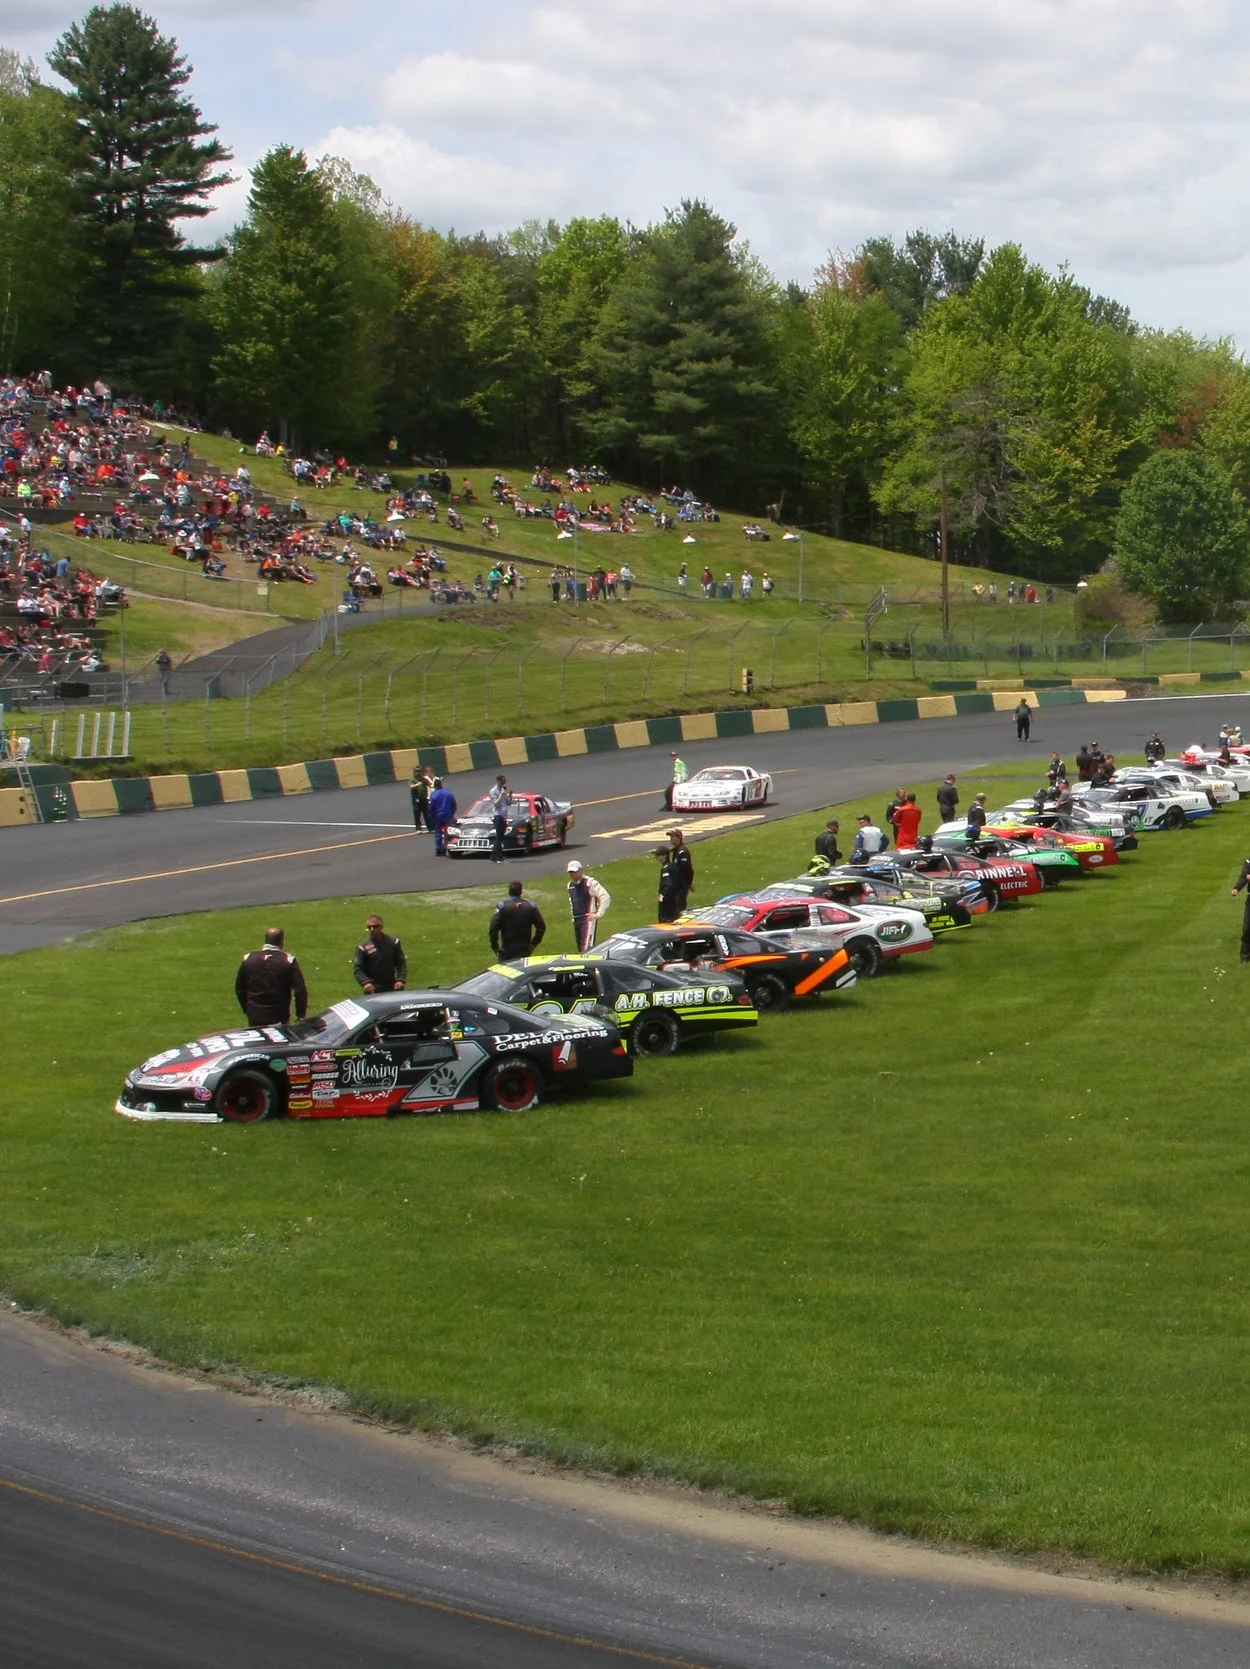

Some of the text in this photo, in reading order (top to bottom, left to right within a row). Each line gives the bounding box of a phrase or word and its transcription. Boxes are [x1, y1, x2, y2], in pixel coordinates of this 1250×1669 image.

[1001, 881, 1028, 889] ELECTRIC
[616, 994, 649, 1010] A.H.
[653, 989, 704, 1006] FENCE
[342, 1059, 399, 1090] Alluring
